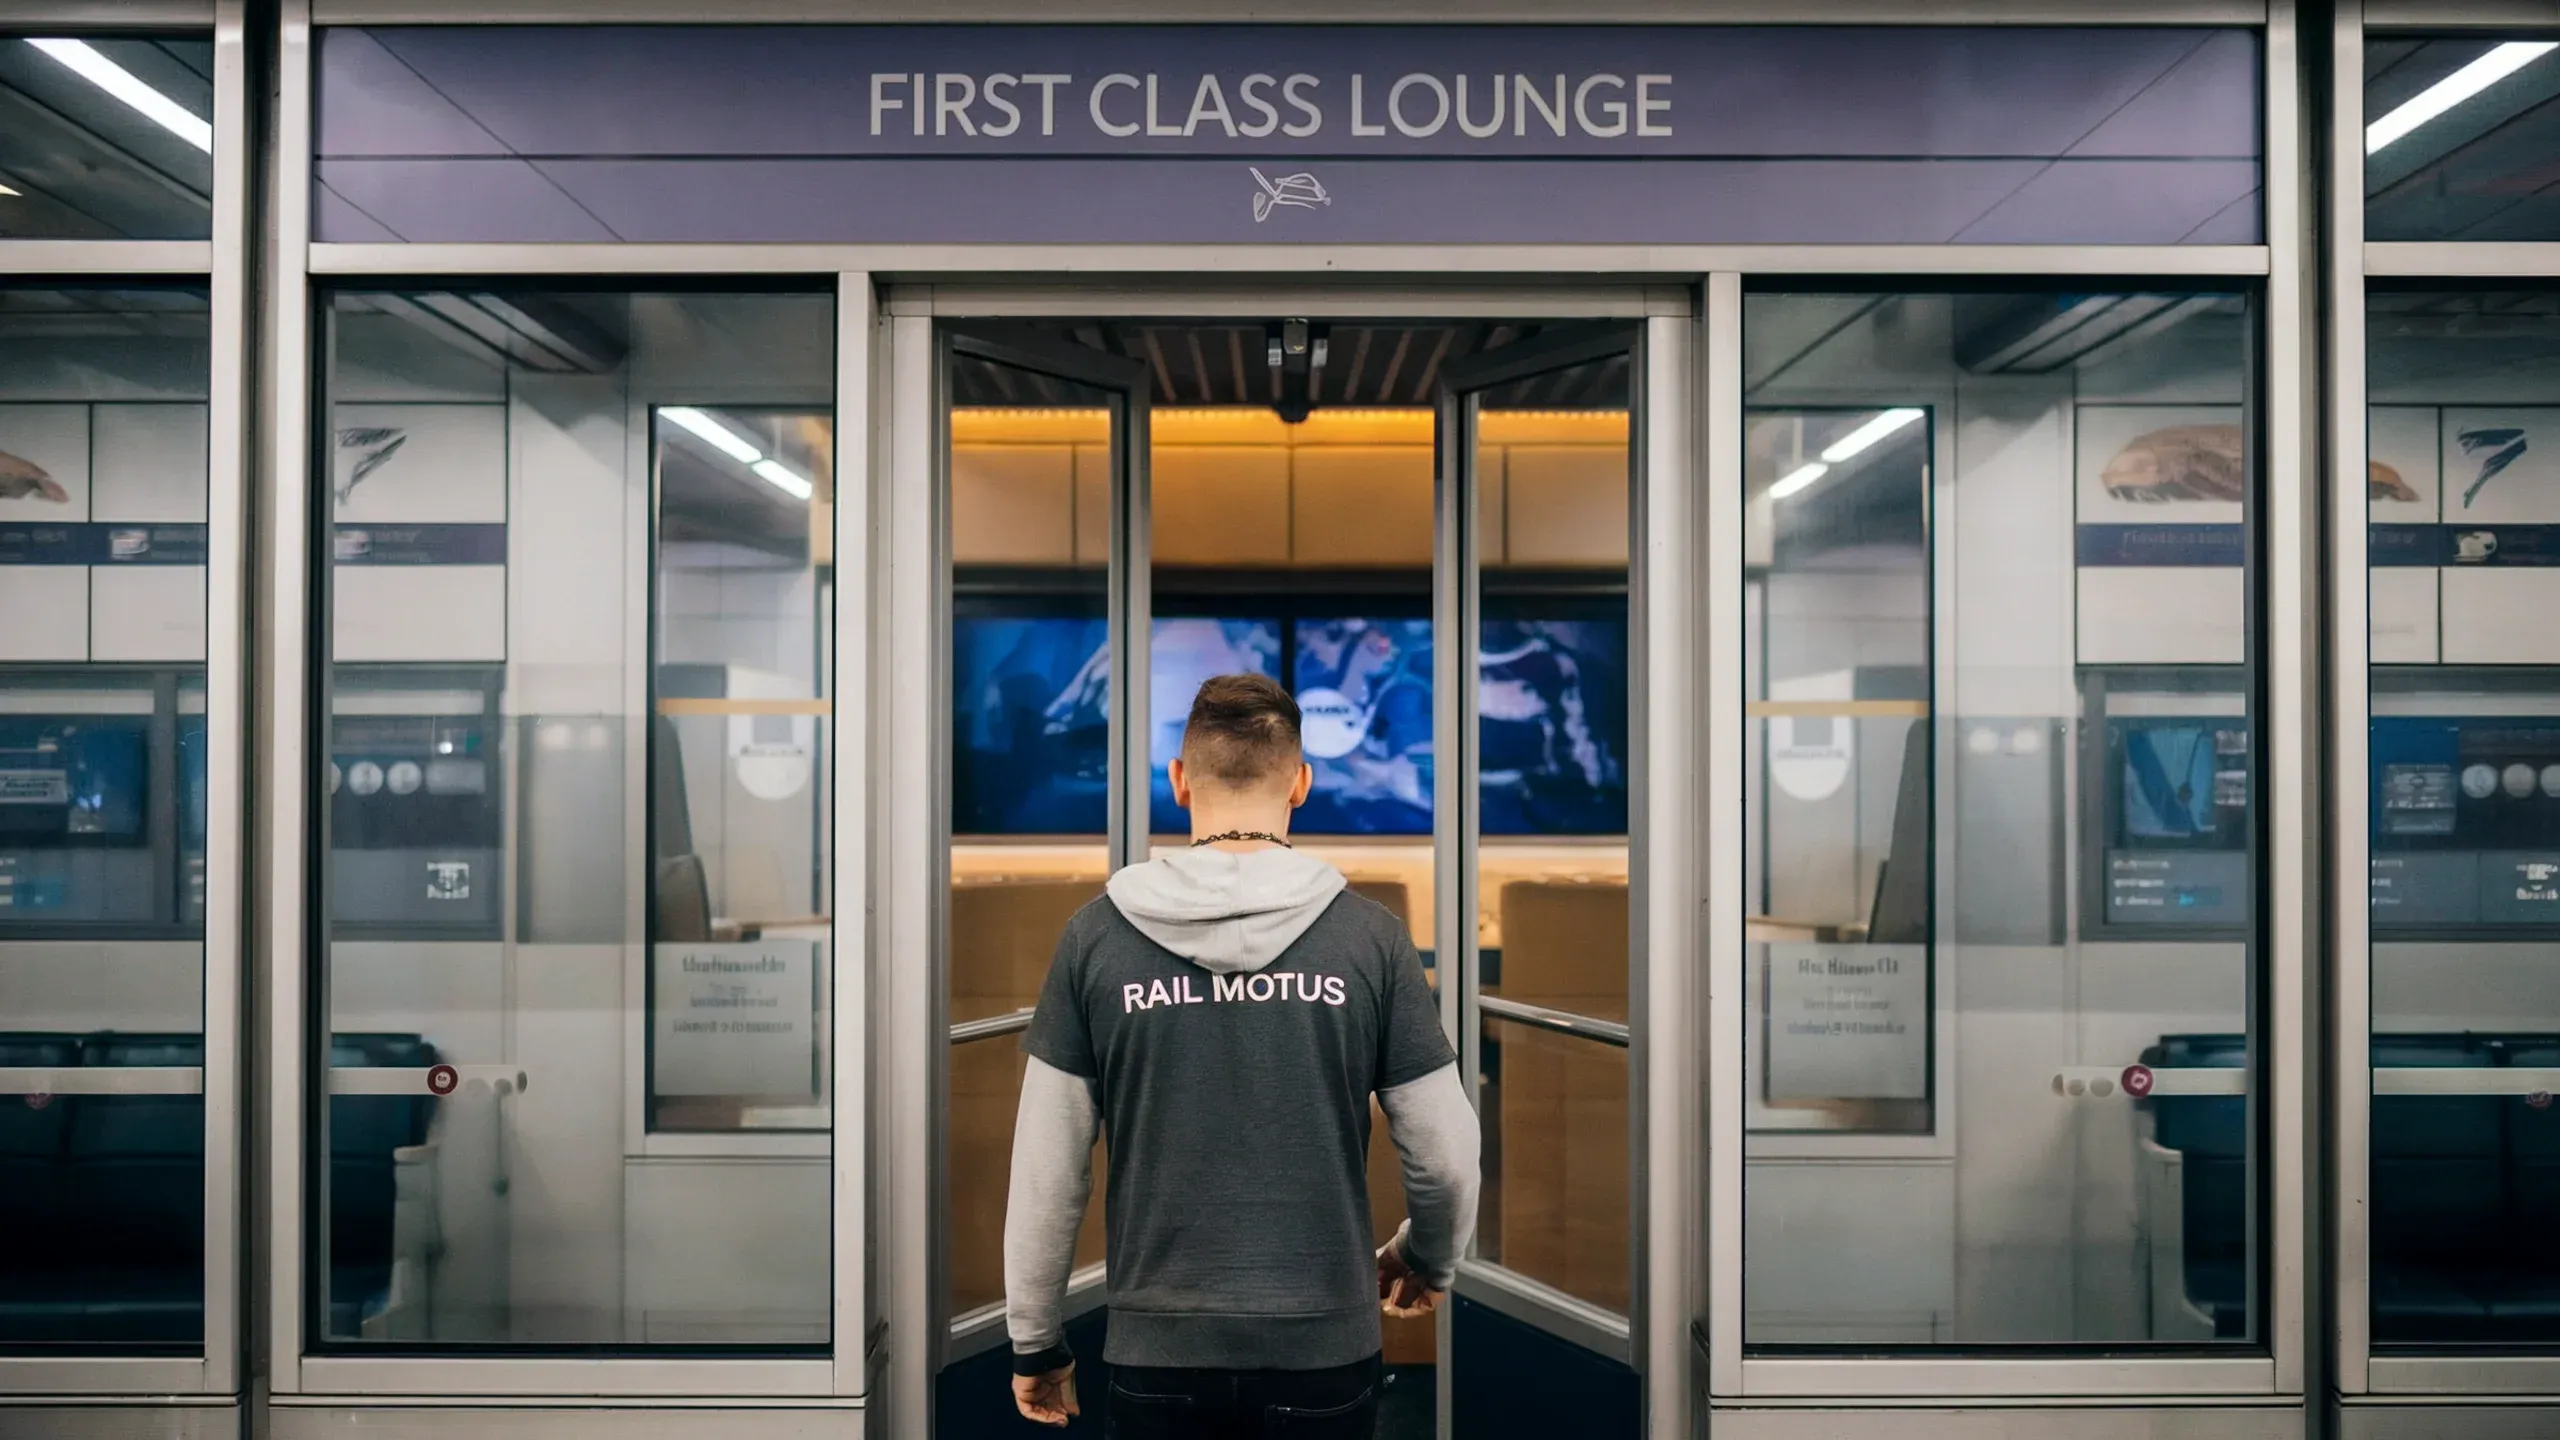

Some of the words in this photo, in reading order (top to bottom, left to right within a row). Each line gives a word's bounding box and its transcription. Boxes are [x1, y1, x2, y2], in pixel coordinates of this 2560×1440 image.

[869, 73, 1071, 137] FIRST
[1089, 72, 1323, 138] CLASS
[1352, 72, 1674, 139] LOUNGE
[1123, 975, 1203, 1013] RAIL
[1212, 972, 1346, 1005] MOTUS
